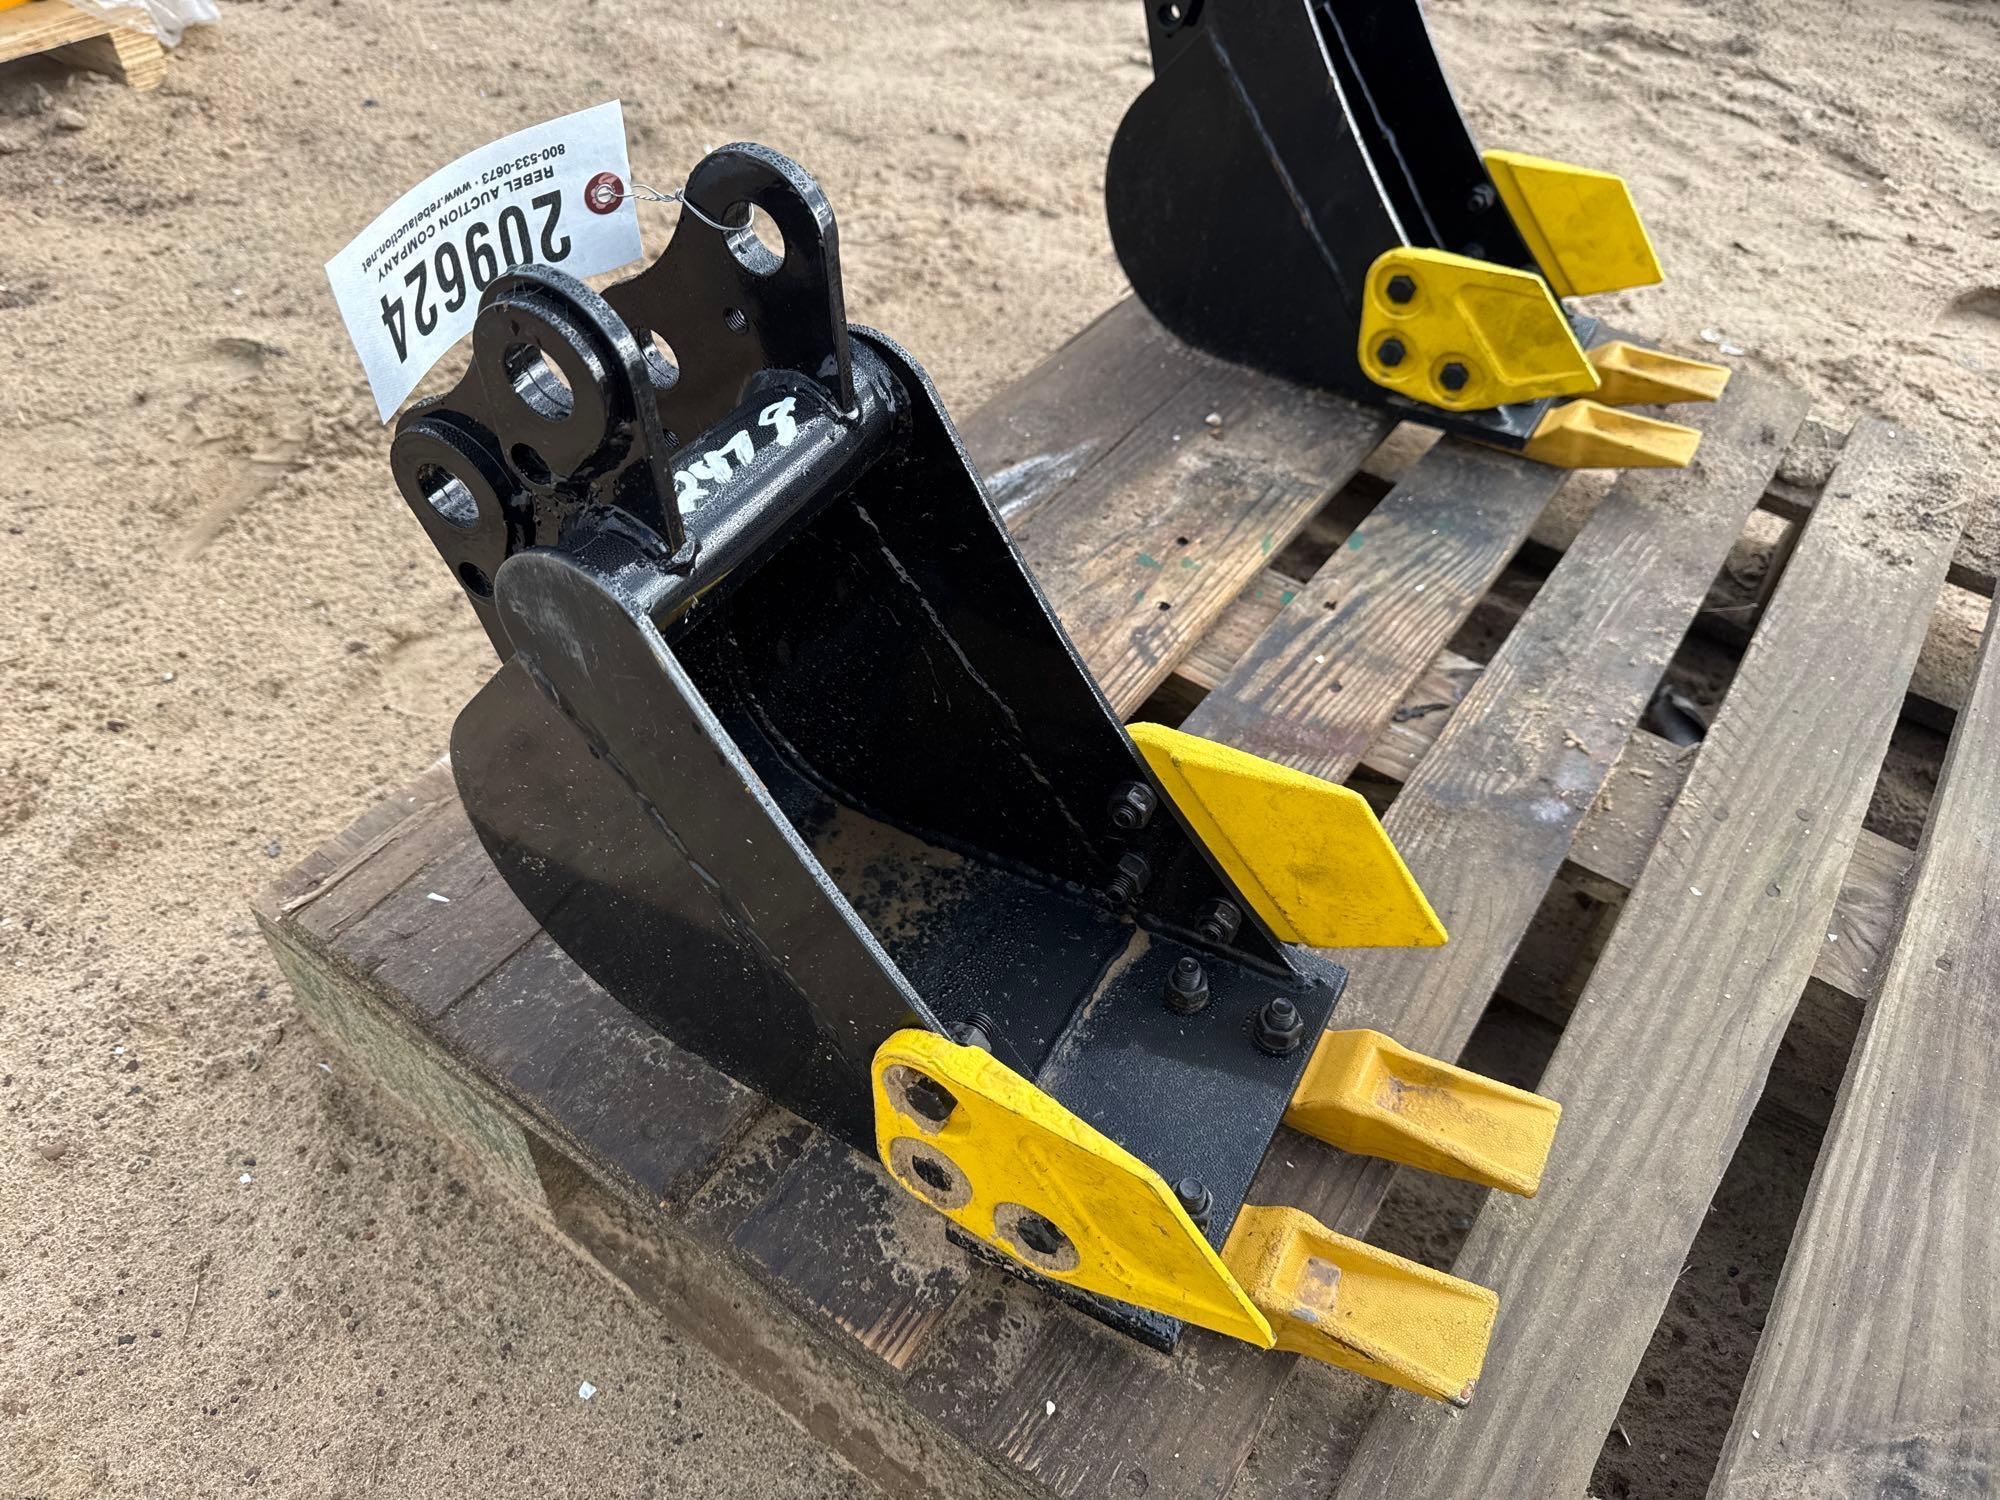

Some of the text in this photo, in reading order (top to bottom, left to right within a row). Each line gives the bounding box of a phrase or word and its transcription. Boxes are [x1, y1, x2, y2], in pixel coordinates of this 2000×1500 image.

[362, 143, 566, 273] 800-533-0673 www.rebelauction.net
[378, 165, 555, 283] REBEL AUCTION COMPANY
[380, 189, 572, 363] 209624
